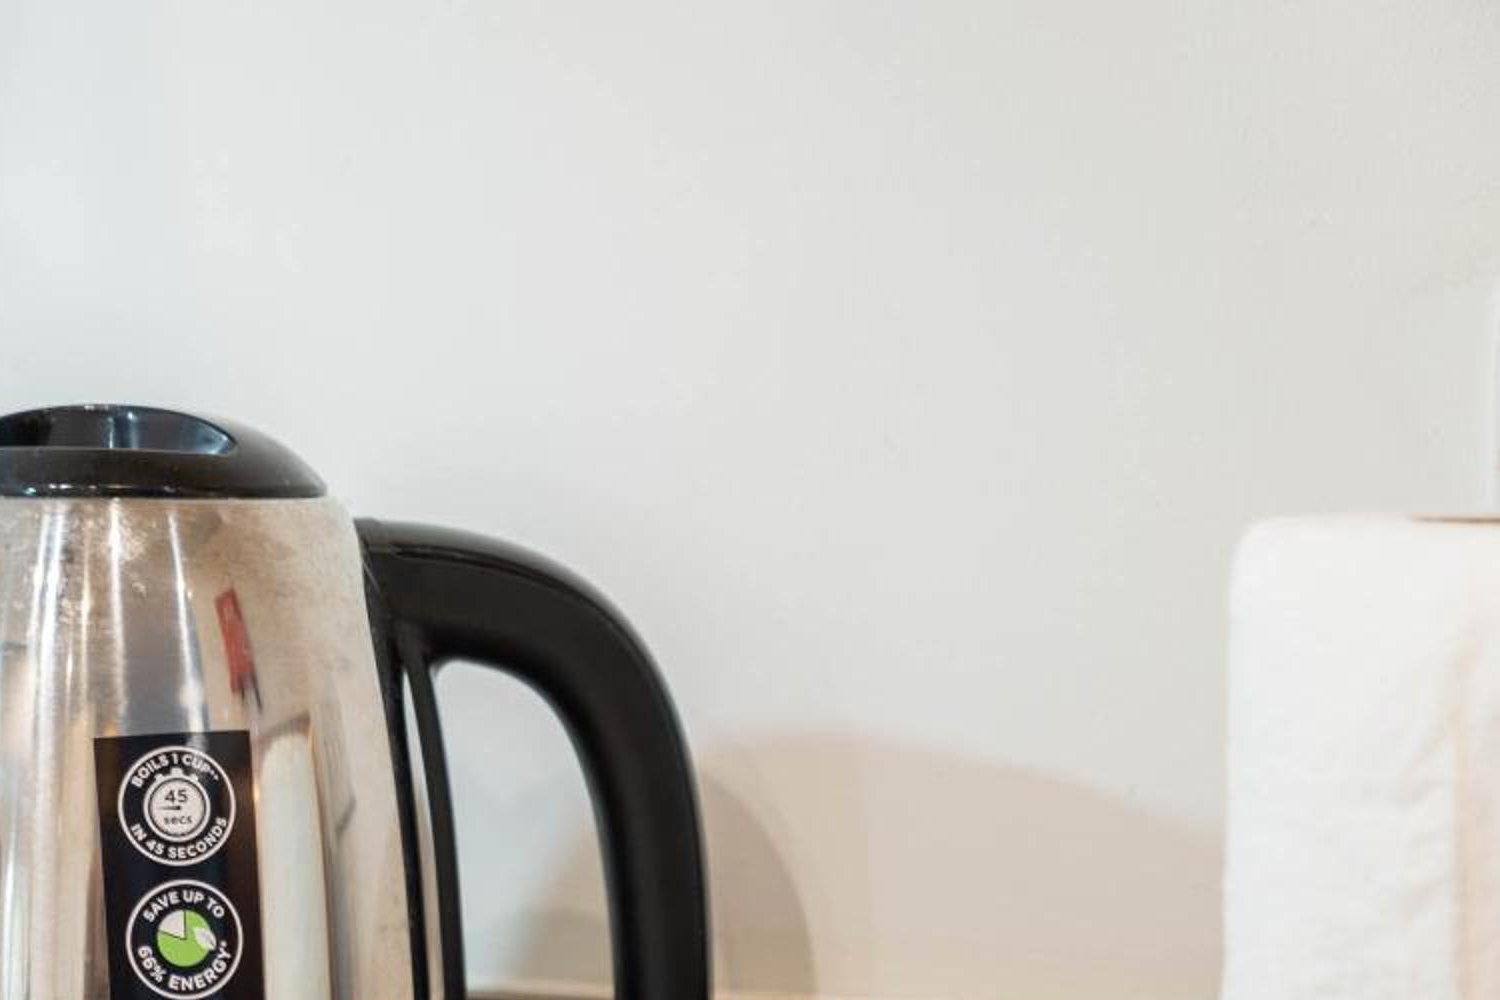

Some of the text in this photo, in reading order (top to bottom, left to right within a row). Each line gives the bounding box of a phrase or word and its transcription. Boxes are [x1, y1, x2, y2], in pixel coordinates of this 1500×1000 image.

[131, 753, 169, 788] BOILS
[171, 753, 178, 765] 1
[164, 789, 188, 804] 45
[163, 815, 192, 825] secs
[130, 816, 227, 860] IN 45 SECONDS
[143, 889, 225, 923] SAVE UP TO
[138, 945, 167, 983] 66%
